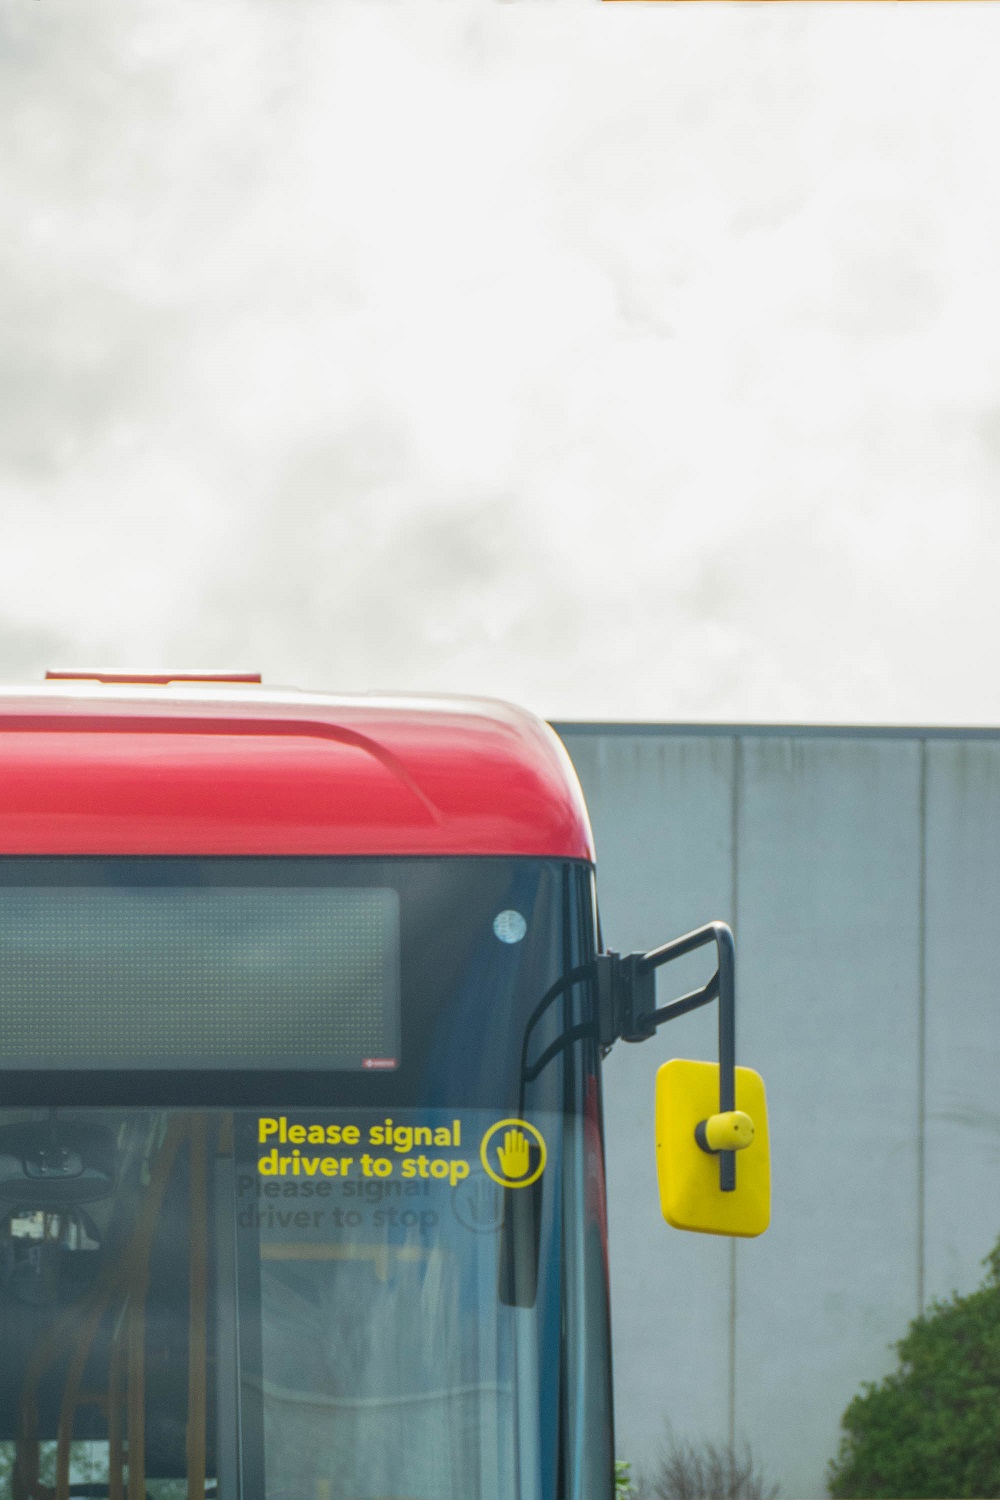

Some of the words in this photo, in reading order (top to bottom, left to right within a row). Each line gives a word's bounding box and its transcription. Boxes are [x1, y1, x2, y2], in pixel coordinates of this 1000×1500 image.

[258, 1117, 360, 1145] Please
[369, 1119, 461, 1153] signal
[258, 1149, 353, 1176] driver
[360, 1153, 392, 1177] to
[401, 1155, 470, 1186] stop
